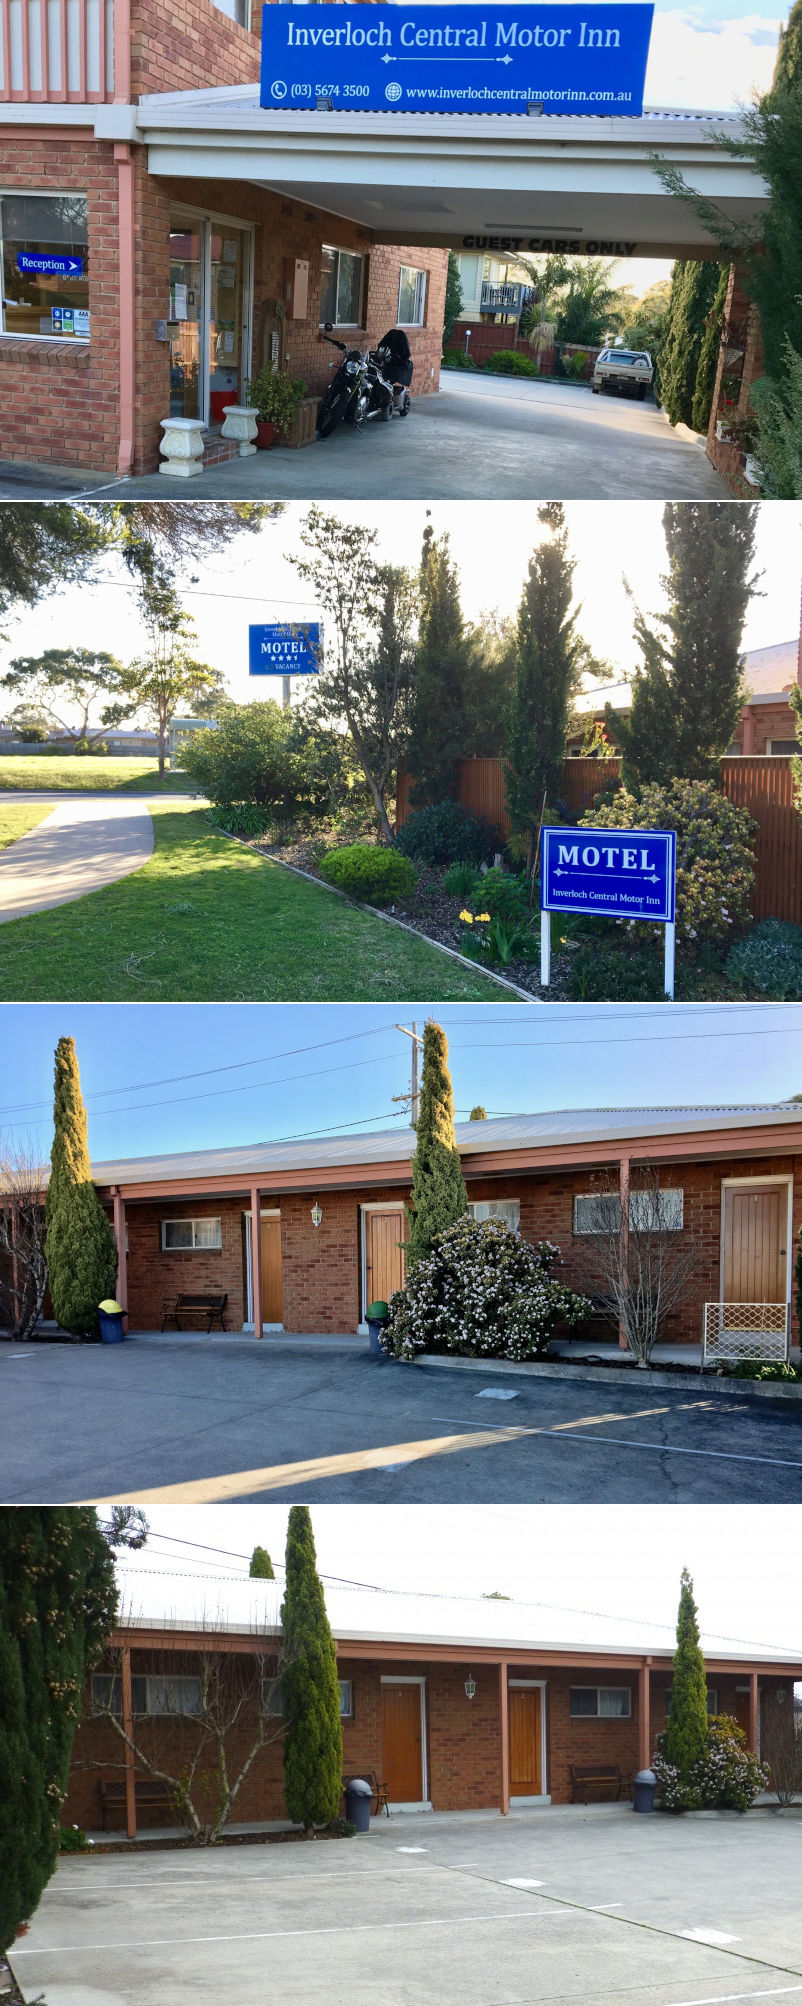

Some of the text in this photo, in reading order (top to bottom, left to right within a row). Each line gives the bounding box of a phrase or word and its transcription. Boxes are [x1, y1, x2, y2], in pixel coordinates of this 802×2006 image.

[287, 21, 621, 47] Inverloch Central Motor Inn
[291, 84, 370, 98] (03) 5674 3500
[406, 87, 632, 101] www.inverlochcentralmotorinn.com.au
[462, 235, 638, 255] GUEST CARS ONLY
[22, 257, 65, 271] Reception
[261, 642, 307, 653] MOTEL
[558, 845, 655, 870] MOTEL
[553, 889, 660, 905] Inverloch Central Motor Inn
